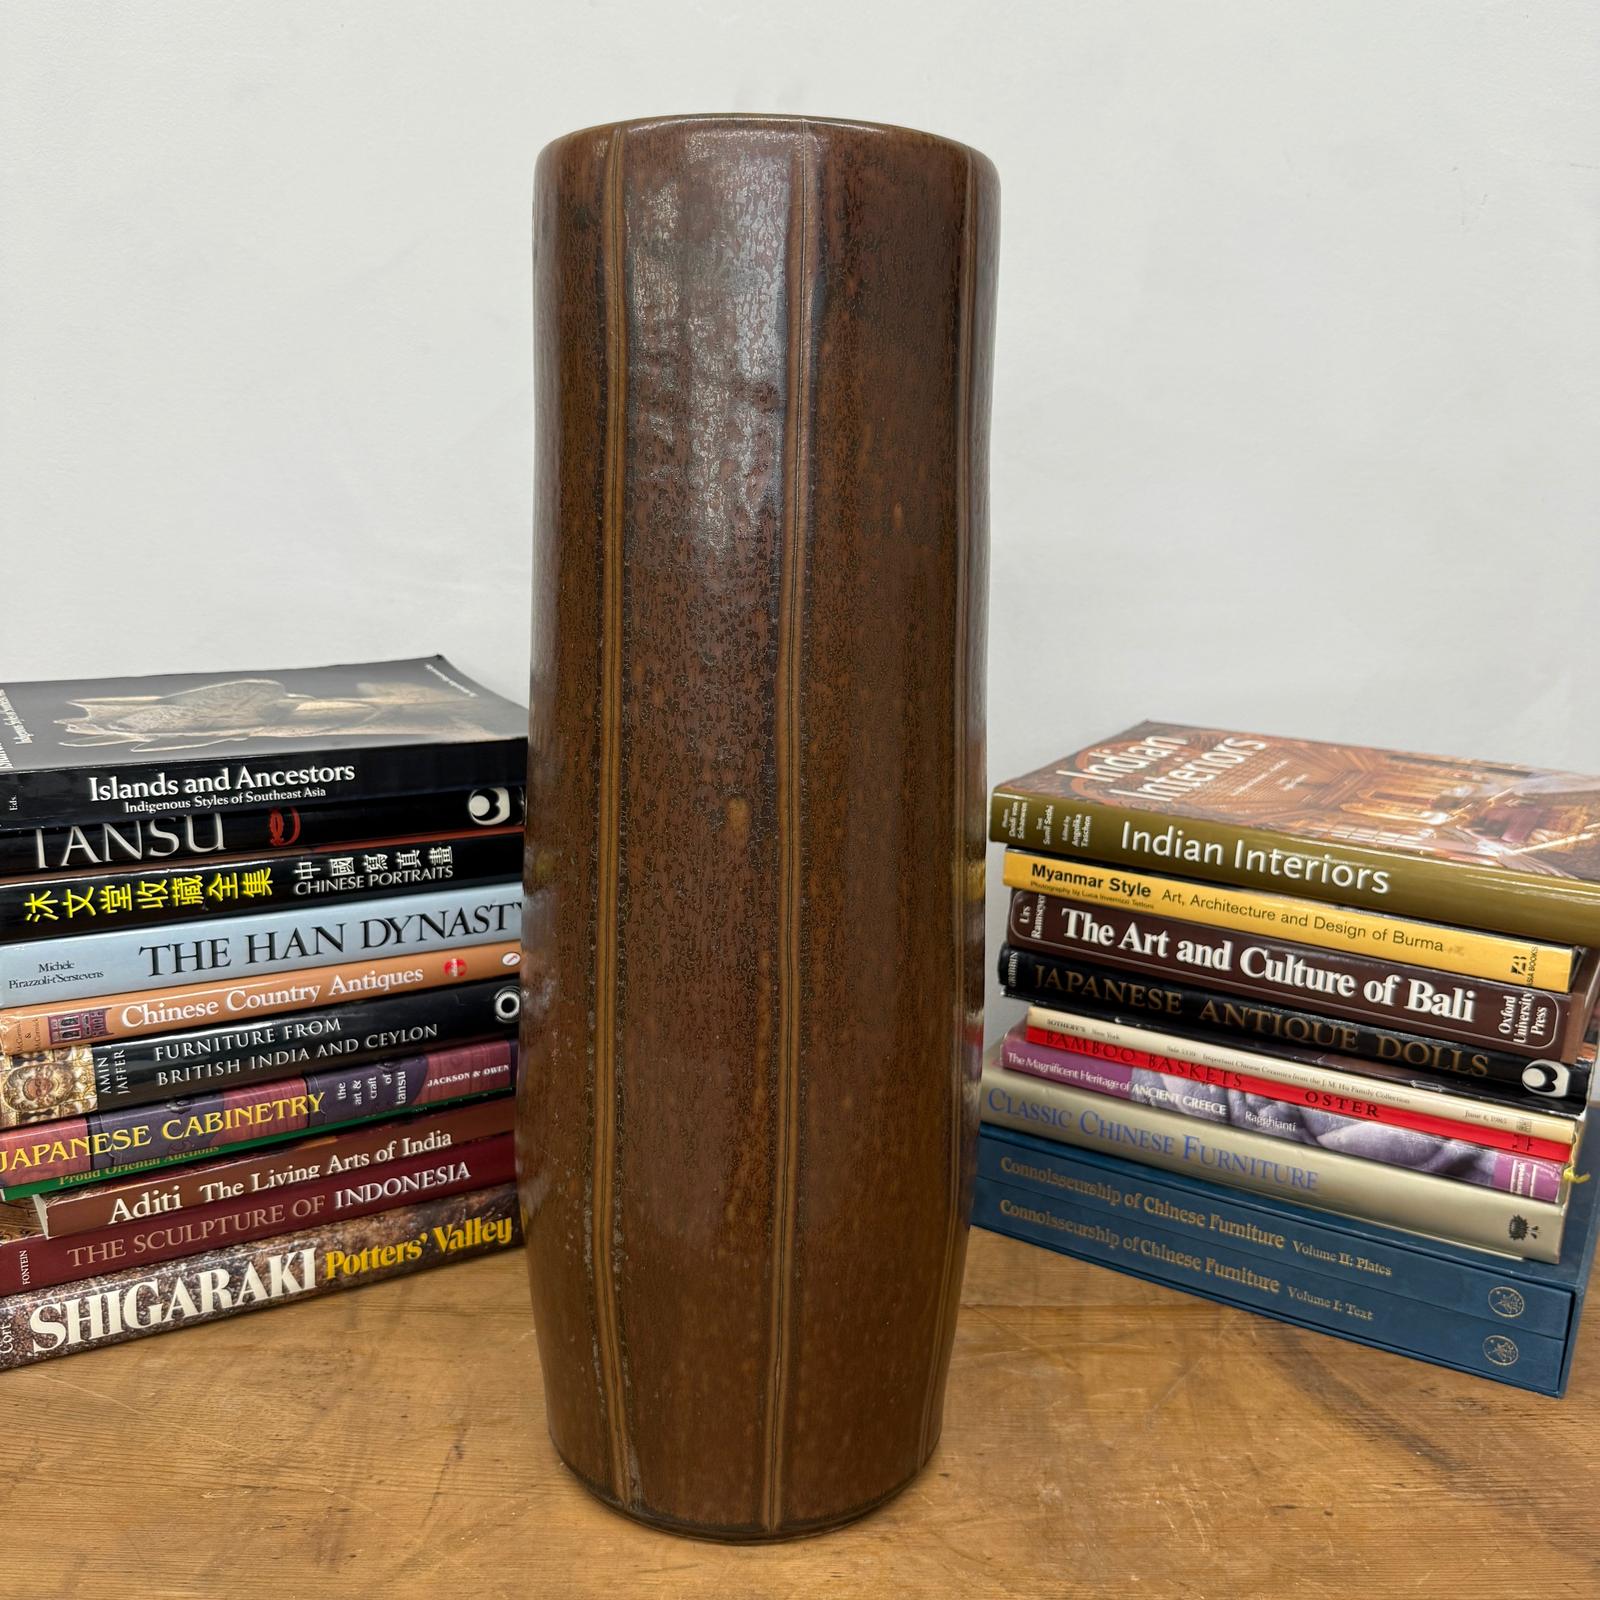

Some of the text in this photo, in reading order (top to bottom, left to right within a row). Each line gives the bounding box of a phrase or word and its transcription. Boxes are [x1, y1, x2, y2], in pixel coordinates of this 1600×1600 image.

[88, 765, 356, 802] Islands and Ancestors
[1056, 735, 1189, 783] Indian
[1109, 737, 1266, 802] Interiors
[125, 787, 326, 814] Indigenous Styles of Southeast Asia
[294, 865, 454, 895] CHINESE PORTRAITS
[1121, 821, 1391, 894] Indian Interiors
[23, 867, 273, 923] 沐文堂收藏全集
[1020, 905, 1031, 924] Urs
[1031, 863, 1444, 952] Myanmar Style Art, Architecture and Design of Burma
[138, 901, 523, 977] THE HAN DYNAST
[1061, 907, 1476, 1023] The Art and Culture of Bali
[121, 967, 424, 1028] Chinese Country Antiques
[1034, 964, 1489, 1077] JAPANESE ANTIQUE DOLLS
[1499, 995, 1516, 1034] Oxford
[1513, 990, 1535, 1043] University
[1531, 1007, 1548, 1036] Press
[154, 1017, 342, 1062] FURNITURE FROM
[157, 1023, 438, 1087] BRITISH INDIA AND CEYLON
[97, 1057, 112, 1094] AMIN
[114, 1049, 131, 1095] JAFFER
[337, 1081, 346, 1099] the
[353, 1080, 362, 1106] art &
[368, 1076, 377, 1099] craft
[382, 1073, 392, 1085] of
[396, 1071, 407, 1105] tansu
[427, 1064, 510, 1087] JACKSON & OWEN
[1007, 1052, 1297, 1133] The Magnificent Heritage of ANCIENT GREECE Ragghianti
[1045, 1032, 1380, 1118] BAMBOO BASKETS OSTER
[0, 1092, 325, 1173] JAPANESE CABINETRY
[988, 1088, 1320, 1190] CLASSIC CHINESE FURNITURE
[108, 1129, 453, 1225] Aditi The Living Arts of India
[67, 1161, 472, 1267] THE SCULPTURE OF INDONESIA
[1001, 1156, 1122, 1206] Connoisseurship
[1124, 1192, 1143, 1209] of
[1143, 1196, 1206, 1227] Chinese
[1209, 1212, 1286, 1249] Furniture
[1292, 1239, 1337, 1262] Volume
[1356, 1256, 1393, 1278] Plates
[19, 1249, 30, 1285] FONTEIN
[29, 1216, 513, 1353] SHIGARAKI Potters' Valley
[1000, 1199, 1120, 1248] Connoisseurship
[1122, 1234, 1139, 1251] of
[1140, 1239, 1201, 1270] Chinese
[1205, 1256, 1281, 1294] Furniture
[1287, 1285, 1331, 1308] Volume
[1346, 1303, 1374, 1321] Text
